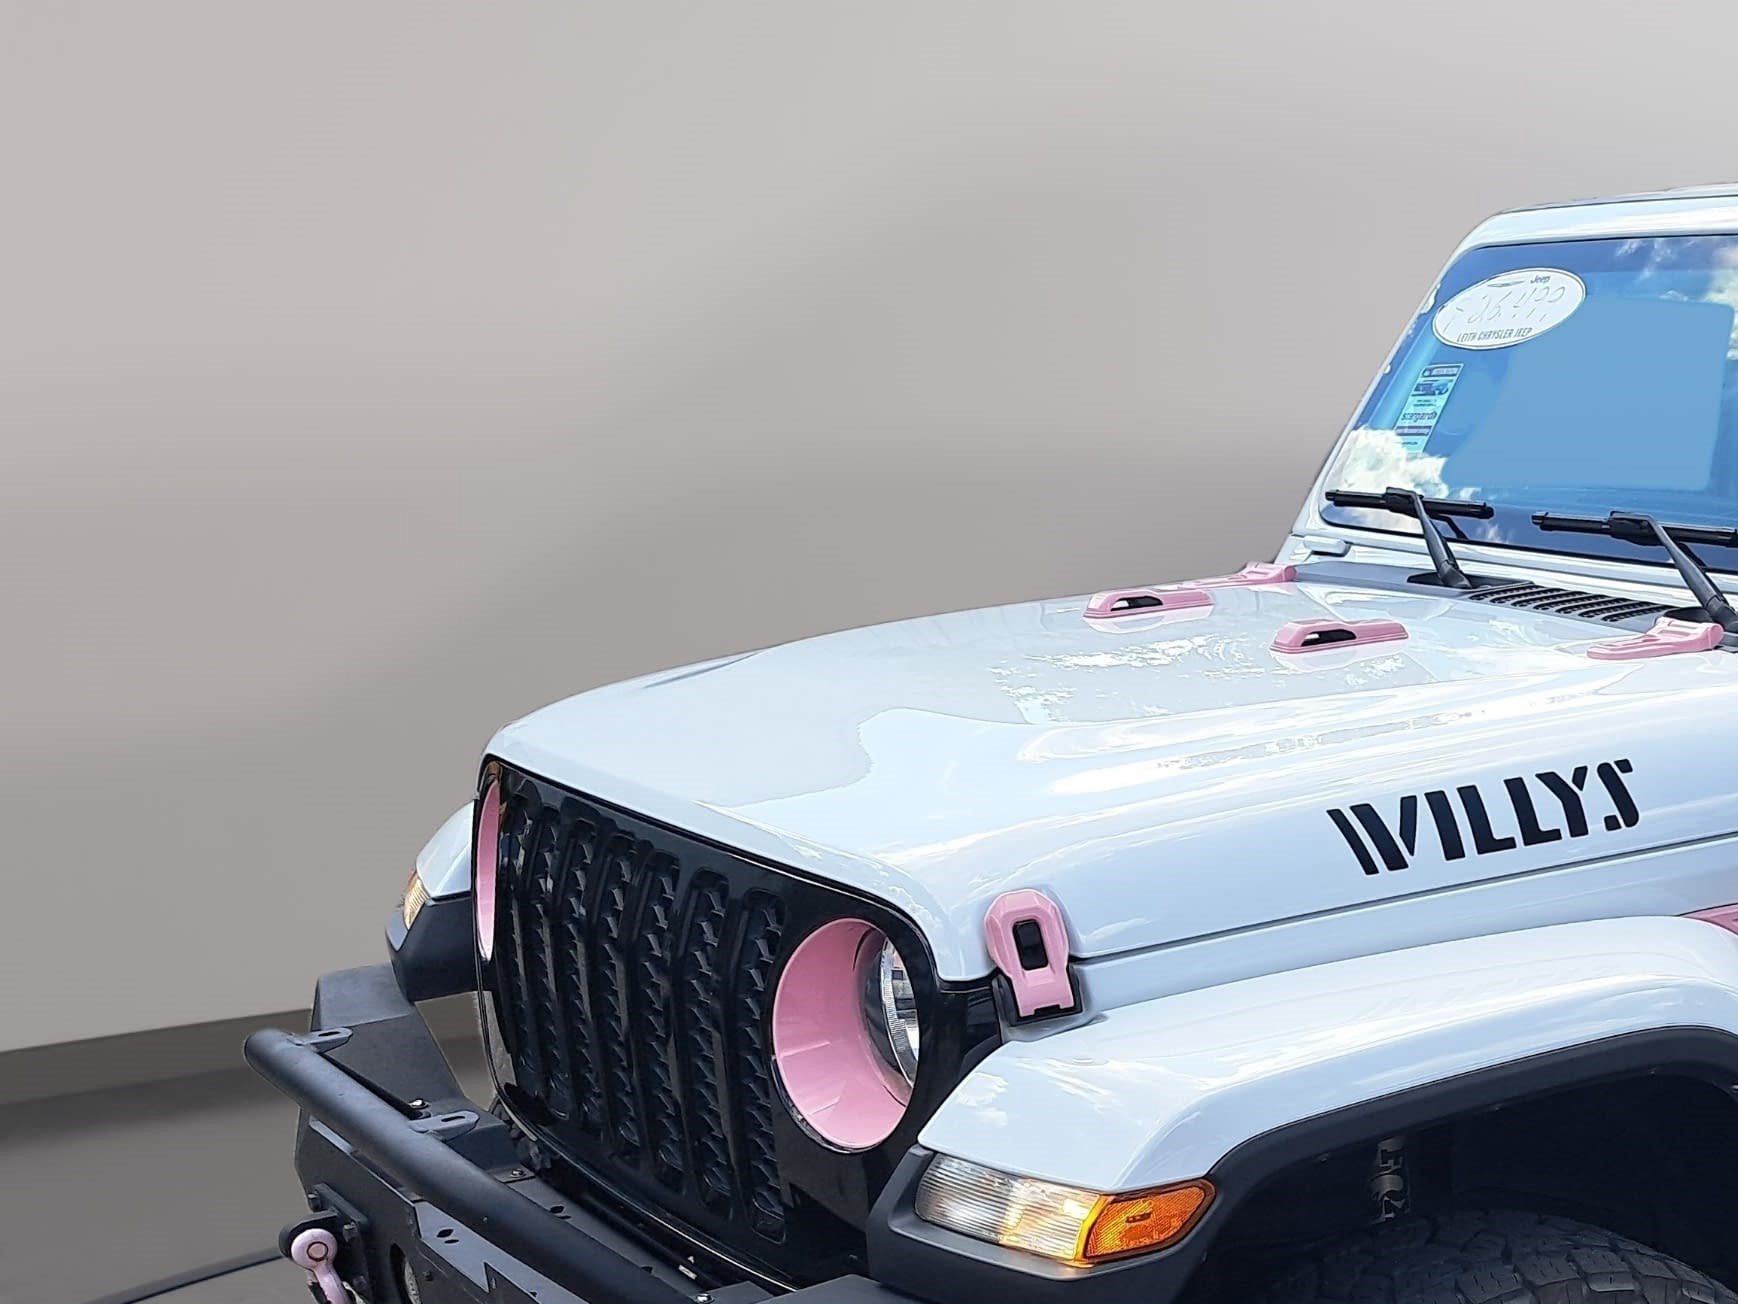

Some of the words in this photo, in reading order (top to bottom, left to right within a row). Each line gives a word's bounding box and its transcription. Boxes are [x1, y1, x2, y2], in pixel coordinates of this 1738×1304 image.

[1530, 275, 1551, 284] Jeep
[1477, 328, 1515, 341] CHRYSLER
[1514, 327, 1533, 338] JEEP
[1326, 758, 1639, 876] WILLYS
